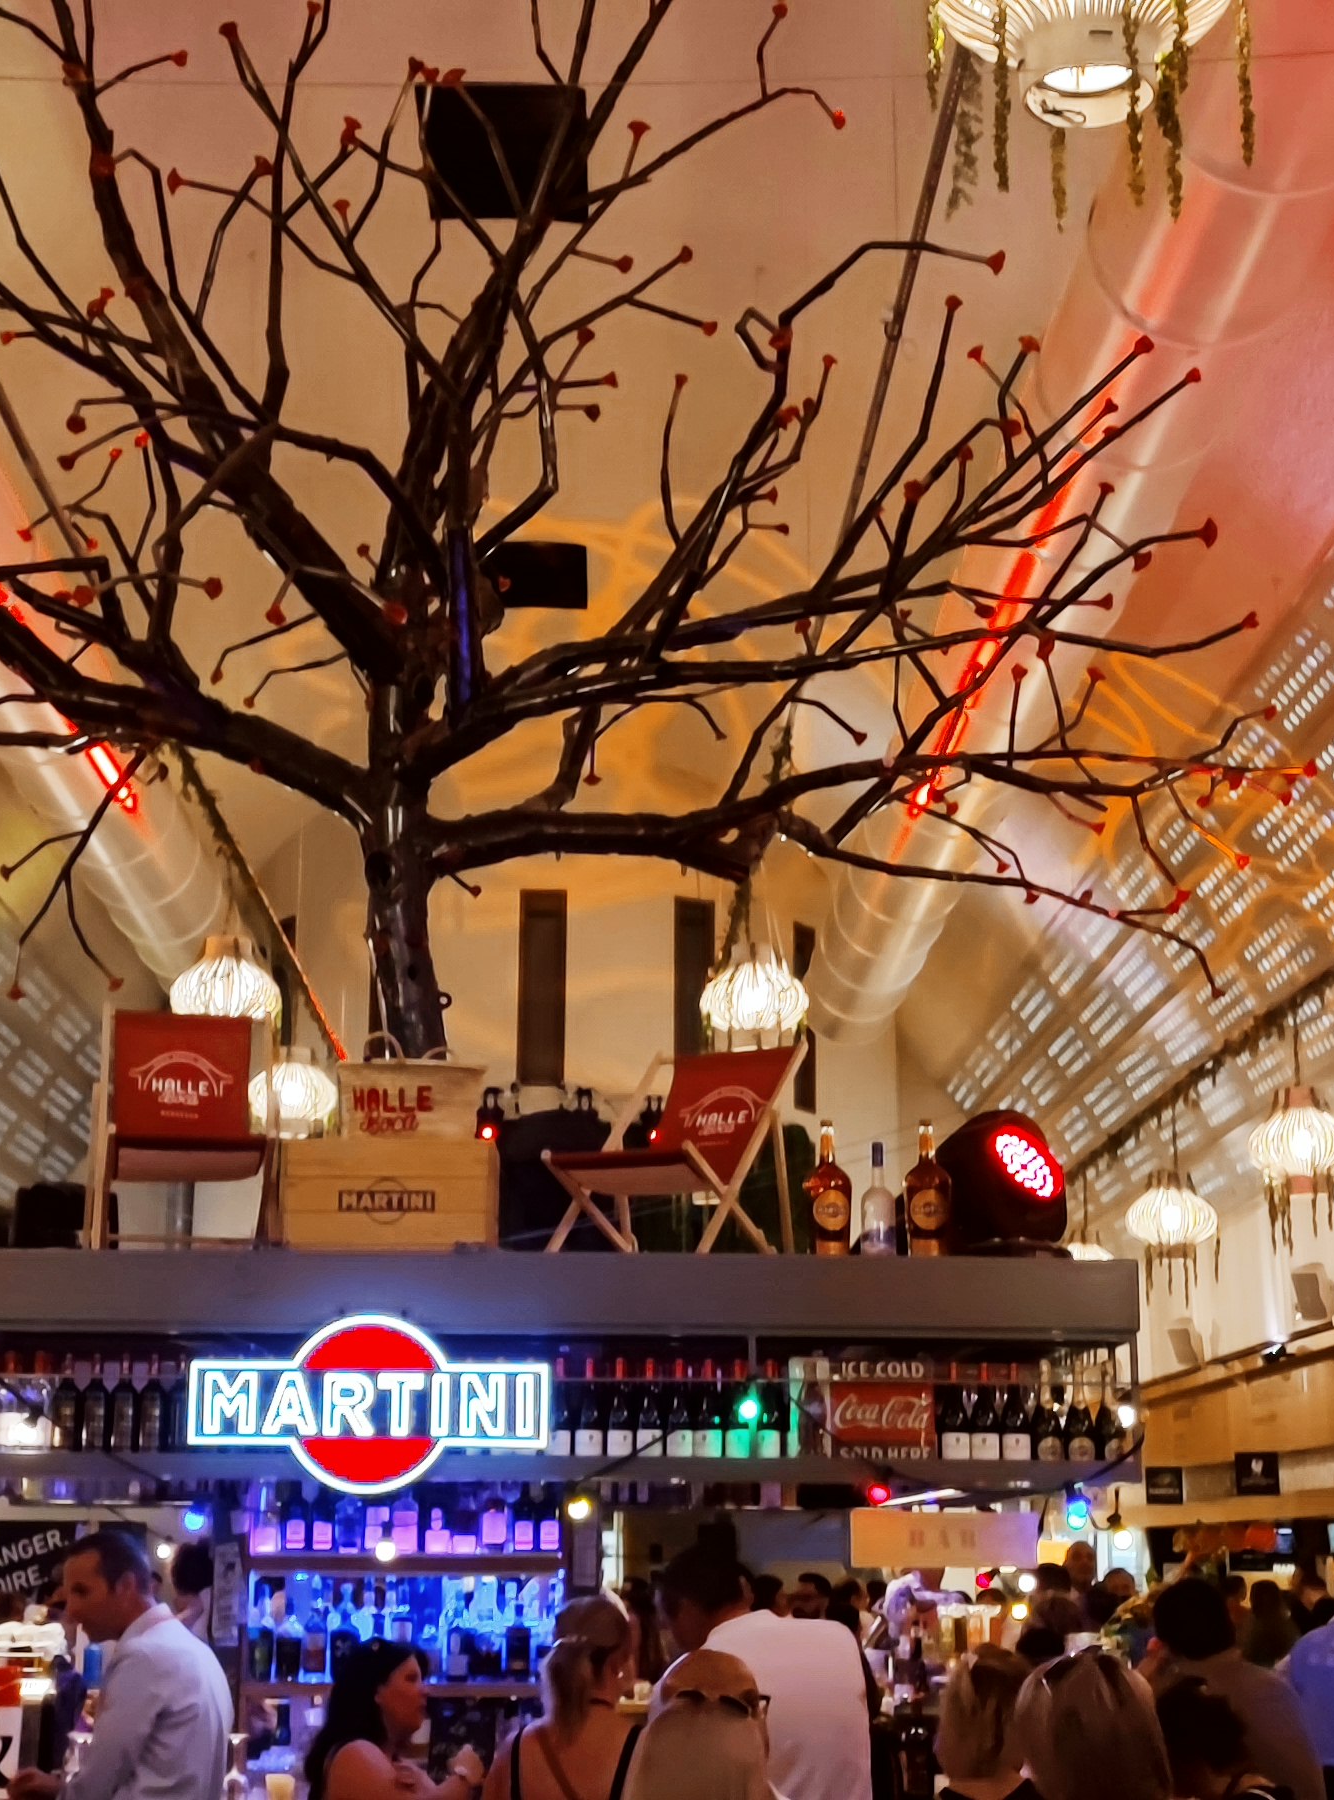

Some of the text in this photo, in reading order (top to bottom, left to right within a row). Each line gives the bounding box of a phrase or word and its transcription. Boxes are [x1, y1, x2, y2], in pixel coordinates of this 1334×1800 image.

[152, 1077, 209, 1096] HALLE
[352, 1086, 433, 1113] HALLE
[696, 1110, 749, 1127] HALLE
[341, 1191, 434, 1210] MARTINI
[841, 1361, 924, 1379] ICE COLD
[202, 1370, 535, 1438] MARTINI
